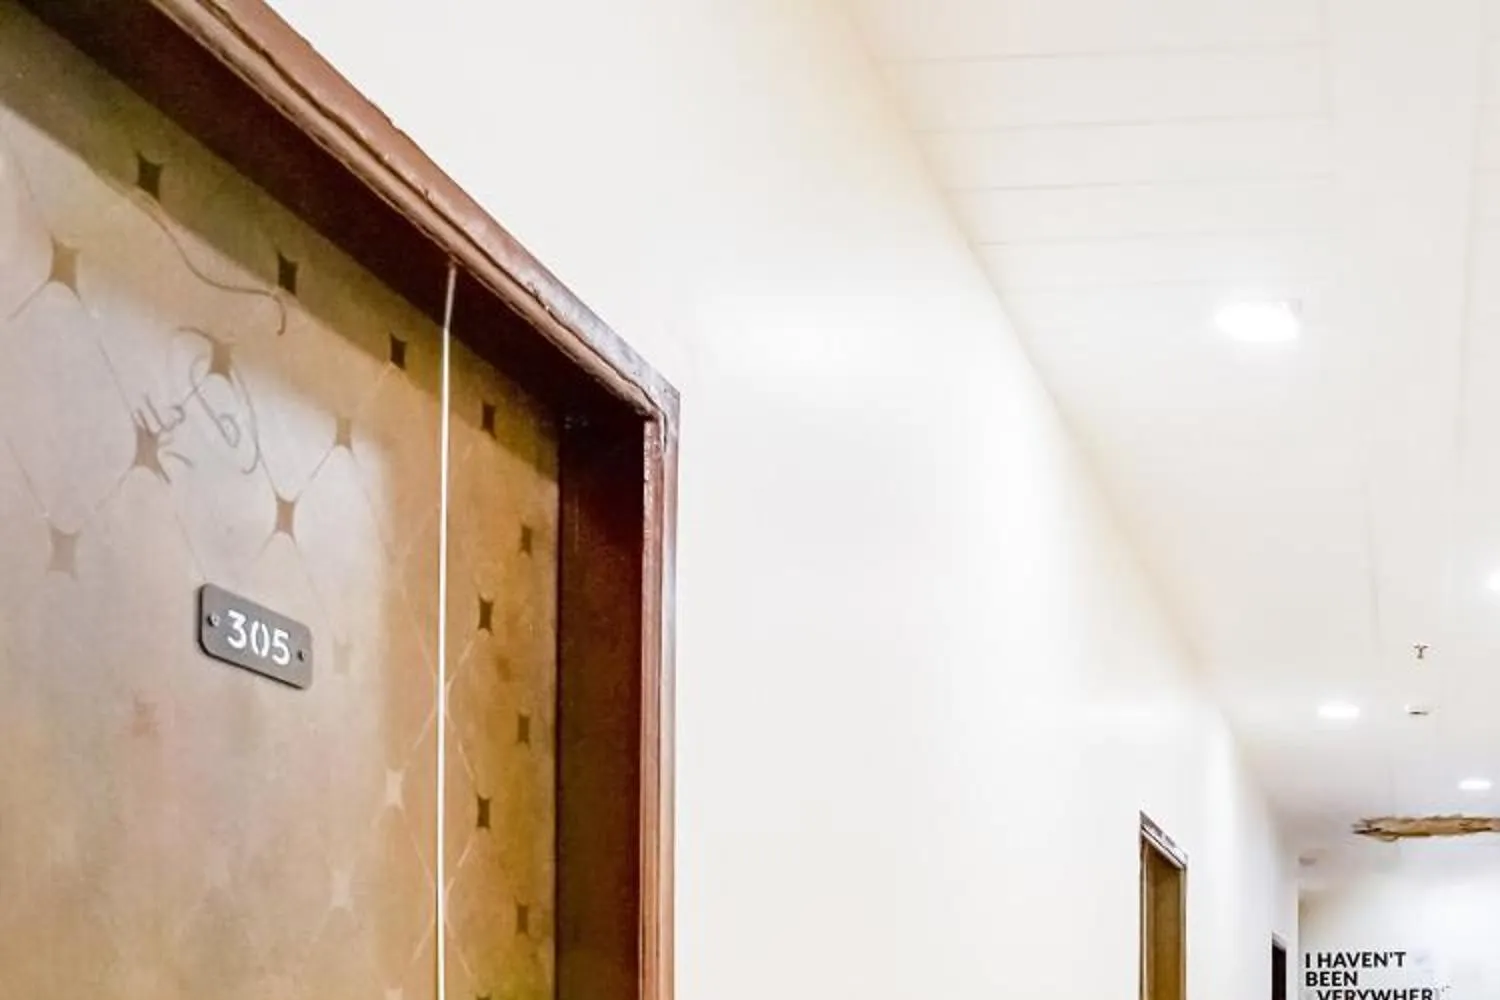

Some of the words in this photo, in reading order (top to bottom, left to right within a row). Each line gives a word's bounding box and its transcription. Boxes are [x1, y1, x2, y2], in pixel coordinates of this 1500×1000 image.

[227, 609, 291, 665] 305
[1305, 952, 1311, 968] I
[1317, 951, 1406, 968] HAVEN'T
[1305, 971, 1358, 987] BEEN
